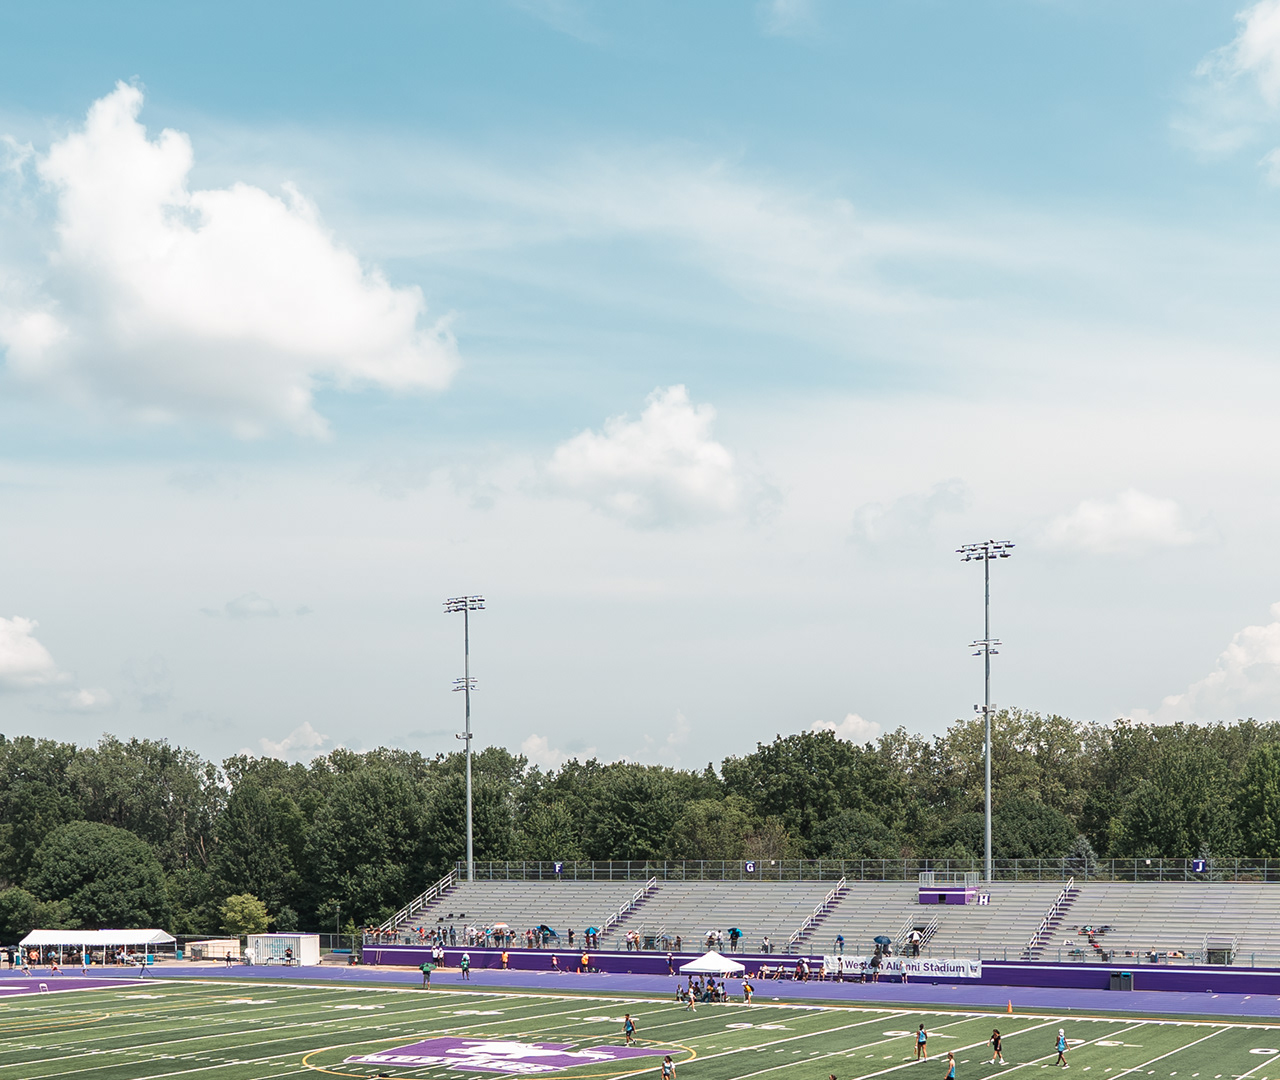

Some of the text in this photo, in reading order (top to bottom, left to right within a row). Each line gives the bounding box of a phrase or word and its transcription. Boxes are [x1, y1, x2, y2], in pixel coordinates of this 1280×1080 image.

[554, 864, 562, 873] F
[746, 863, 755, 873] G
[979, 894, 989, 905] H
[923, 963, 964, 973] Stadium
